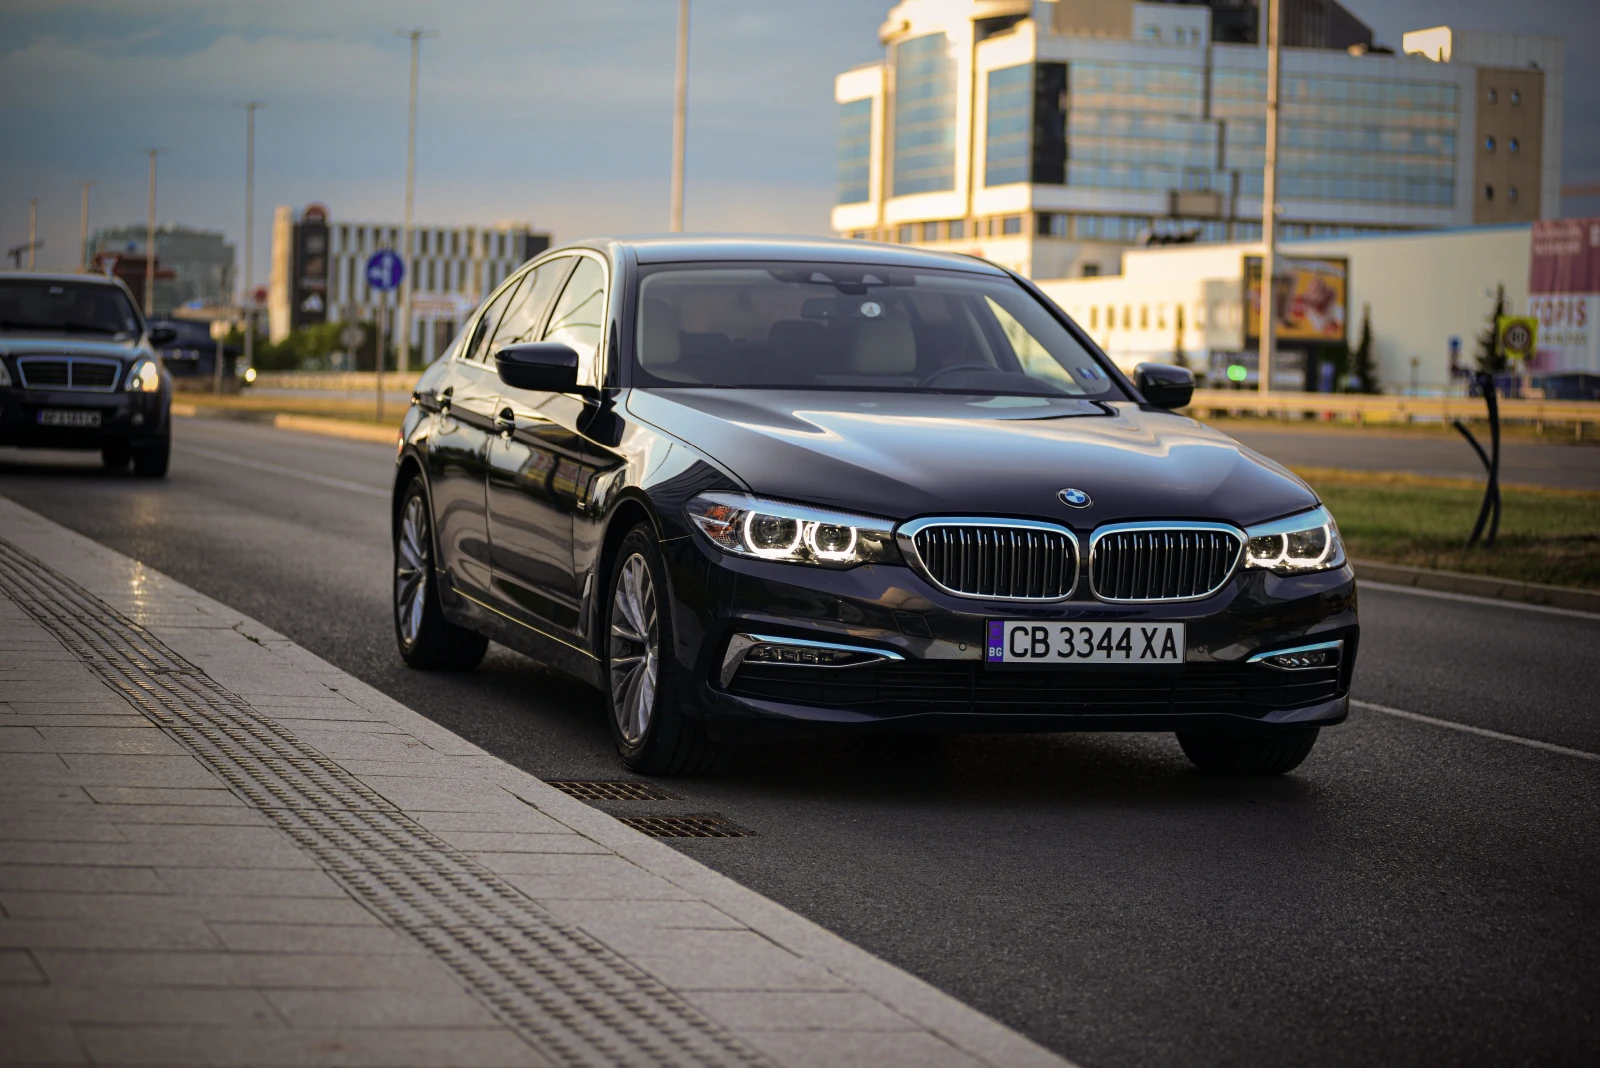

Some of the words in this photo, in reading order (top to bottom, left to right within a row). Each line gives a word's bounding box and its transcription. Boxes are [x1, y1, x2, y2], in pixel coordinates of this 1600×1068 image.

[988, 647, 1002, 657] BG
[1009, 626, 1050, 658] CB
[1057, 626, 1132, 659] 3344
[1140, 627, 1177, 659] XA
